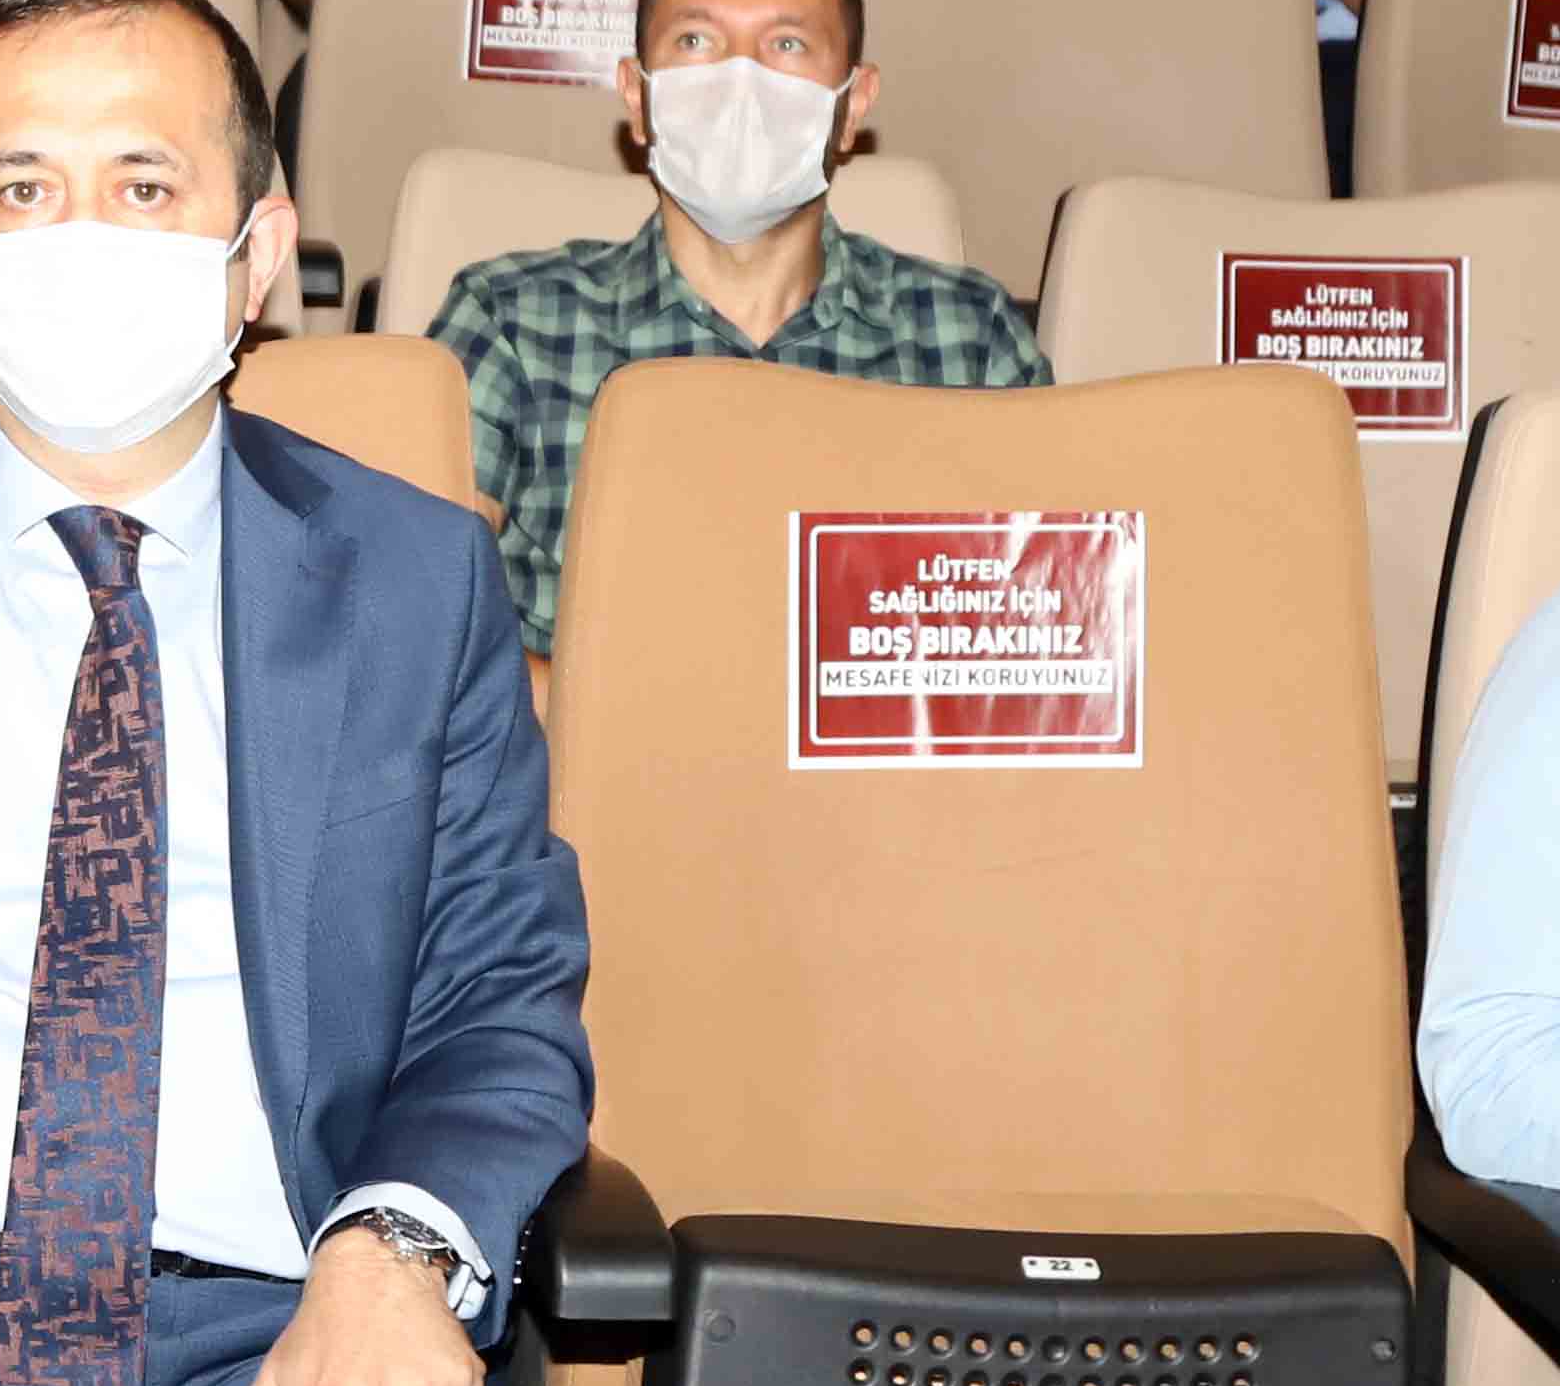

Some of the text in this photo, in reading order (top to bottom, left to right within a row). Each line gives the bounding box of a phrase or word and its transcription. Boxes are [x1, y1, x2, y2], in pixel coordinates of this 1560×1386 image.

[1305, 283, 1373, 305] LÜTFEN
[1271, 306, 1408, 332] SAĞLIĞINIZ İÇİN
[1256, 334, 1424, 363] BOŞ BIRAKINIZ
[1341, 366, 1441, 381] KORUYUNUZ
[918, 554, 1011, 582] LÜTFEN
[869, 585, 1061, 619] SAĞLIĞINIZ İÇİN
[849, 625, 1083, 663] BOŞ BIRAKINIZ
[969, 667, 1108, 686] KORUYUNUZ
[1049, 1260, 1073, 1271] 22
